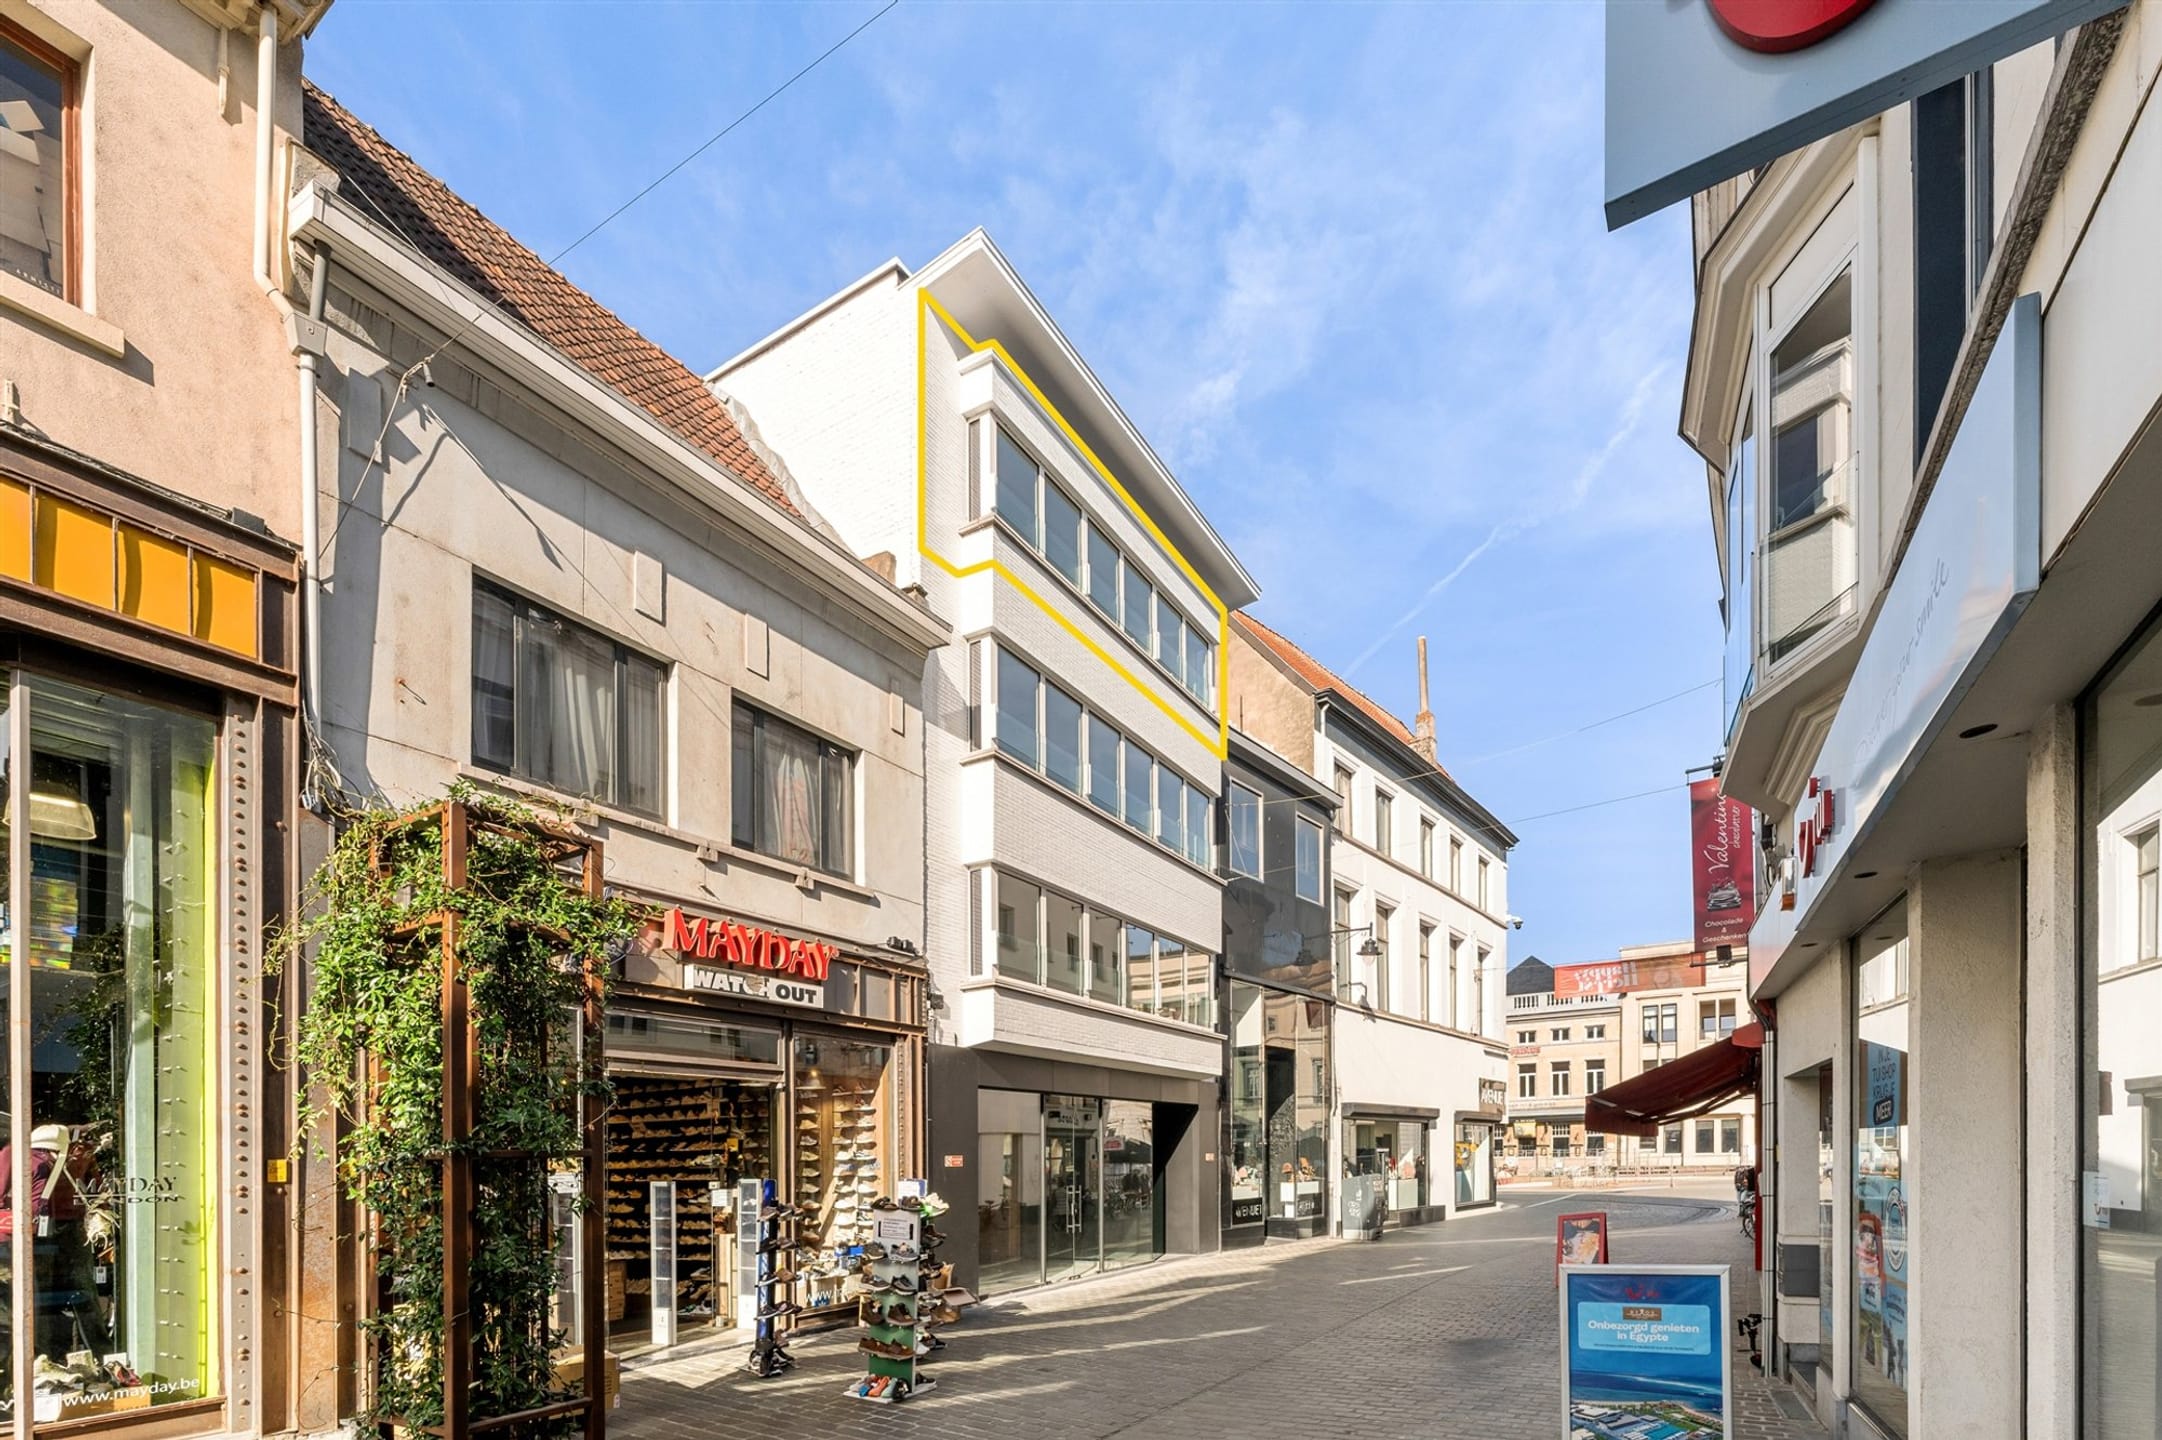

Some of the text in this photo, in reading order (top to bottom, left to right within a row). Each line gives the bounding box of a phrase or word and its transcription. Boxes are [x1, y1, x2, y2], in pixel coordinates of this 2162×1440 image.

[661, 908, 834, 980] MAYDAY
[775, 983, 817, 1004] OUT
[1588, 1319, 1700, 1334] Onbezorgd genieten
[1617, 1330, 1669, 1343] in Egypte
[63, 1377, 200, 1407] www.mayday.be
